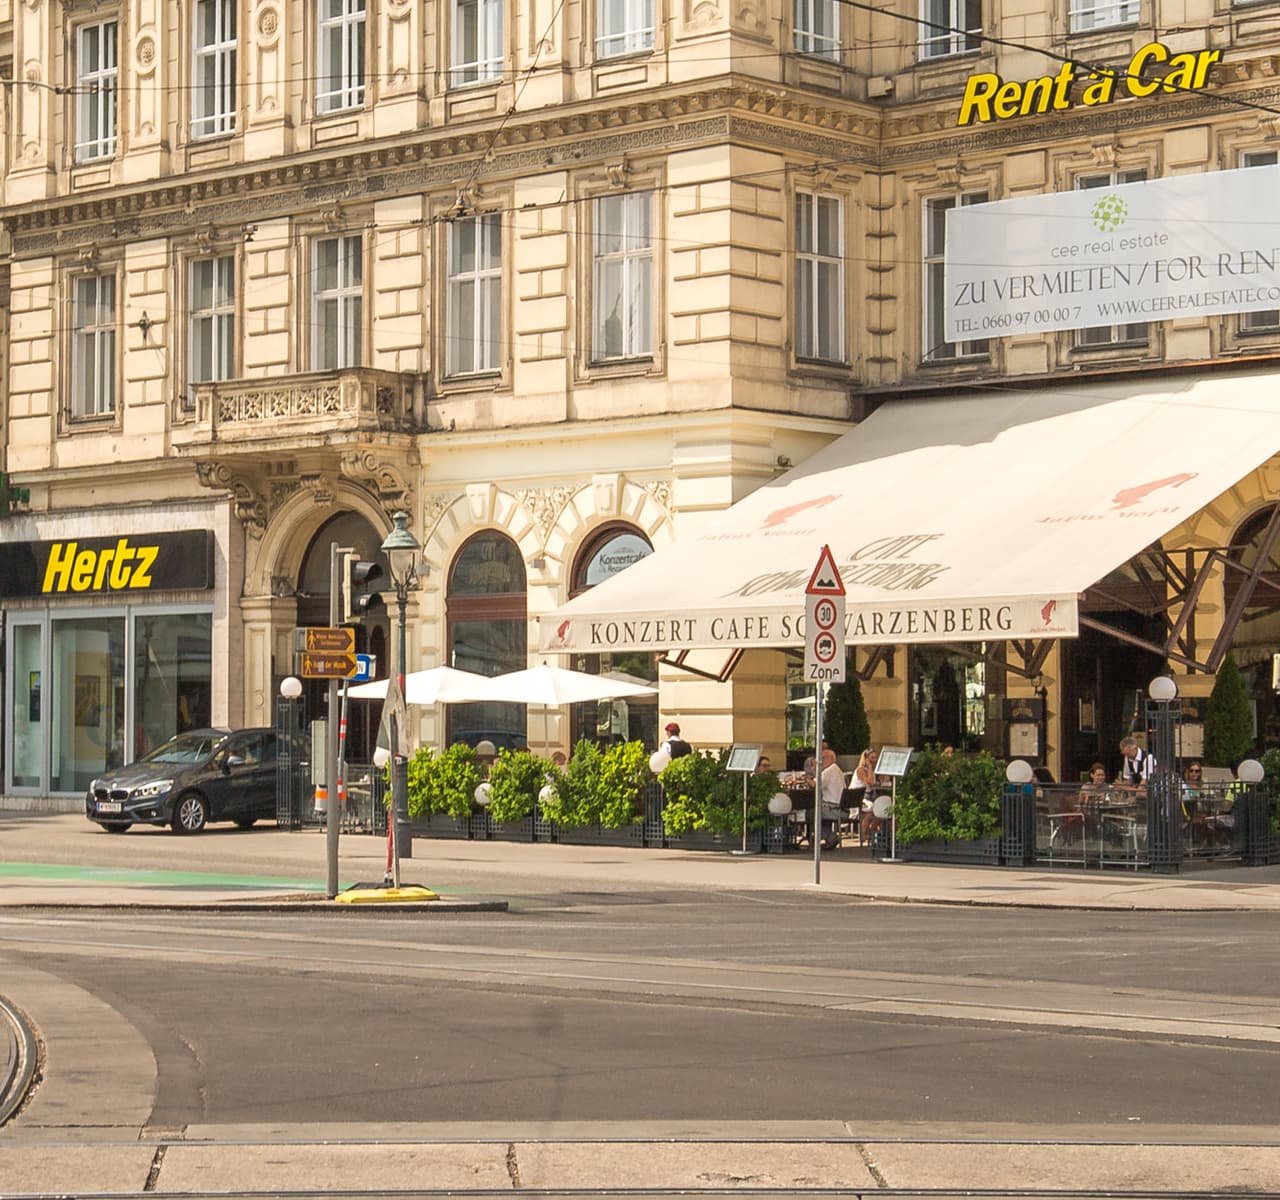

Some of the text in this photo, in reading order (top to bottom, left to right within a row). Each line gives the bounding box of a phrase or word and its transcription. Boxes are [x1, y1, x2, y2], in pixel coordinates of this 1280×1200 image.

[958, 42, 1221, 126] Rent a Car
[1051, 231, 1168, 259] cee real estate
[954, 280, 985, 307] ZU
[993, 264, 1132, 300] VERMIETEN
[1154, 255, 1207, 284] FOR
[982, 314, 1012, 330] 0660
[1015, 311, 1031, 326] 97
[1034, 309, 1050, 324] 00
[1053, 307, 1070, 322] 00
[1073, 306, 1082, 320] 7
[42, 538, 160, 593] Hertz
[591, 605, 1013, 645] KONZERT CAFE SCARZENBERG
[821, 607, 831, 621] 30
[810, 663, 840, 680] Zone
